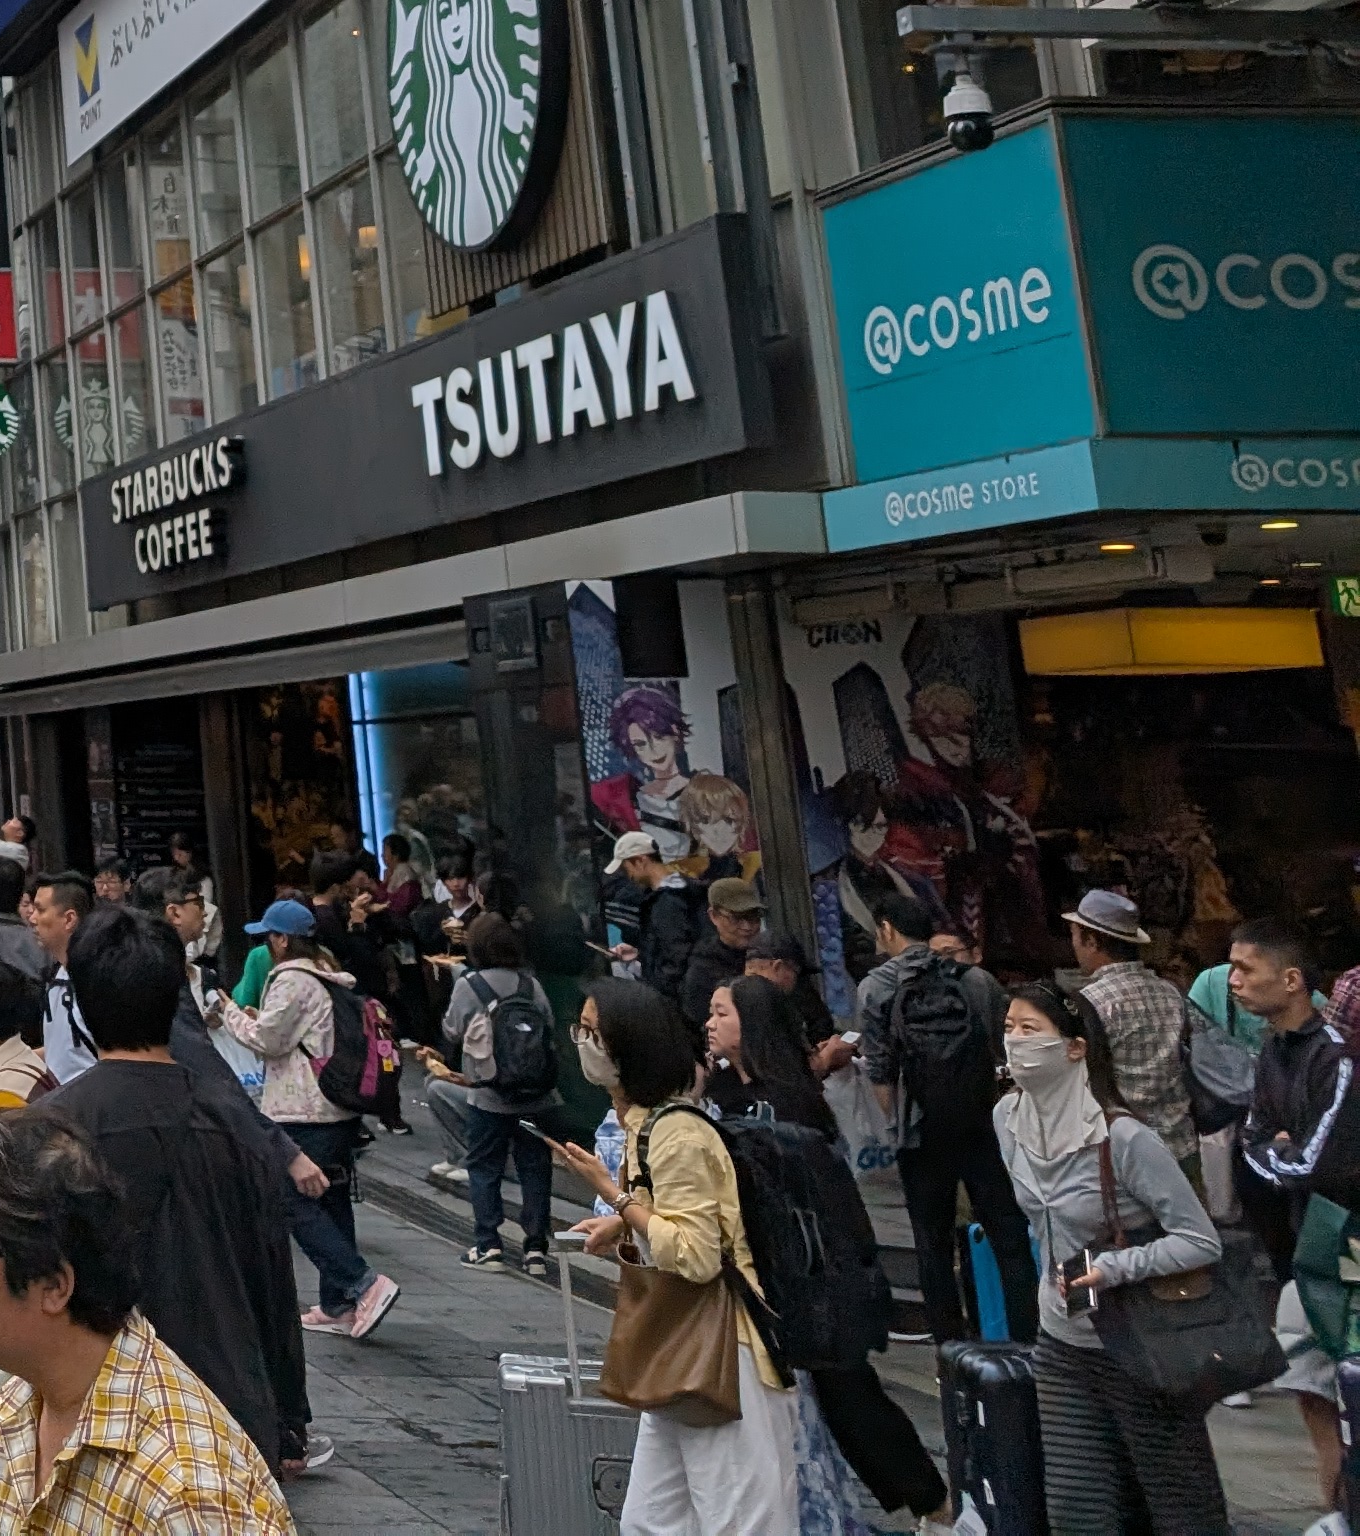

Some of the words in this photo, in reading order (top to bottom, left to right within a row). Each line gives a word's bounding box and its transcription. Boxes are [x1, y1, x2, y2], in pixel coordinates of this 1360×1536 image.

[80, 98, 102, 134] POINT
[864, 266, 1052, 375] @cosme
[412, 289, 697, 477] TSUTAYA
[110, 437, 233, 525] STARBUCKS
[885, 481, 975, 526] @cosme
[980, 472, 1040, 504] STORE
[1231, 453, 1360, 493] @cos
[134, 508, 214, 574] COFFEE
